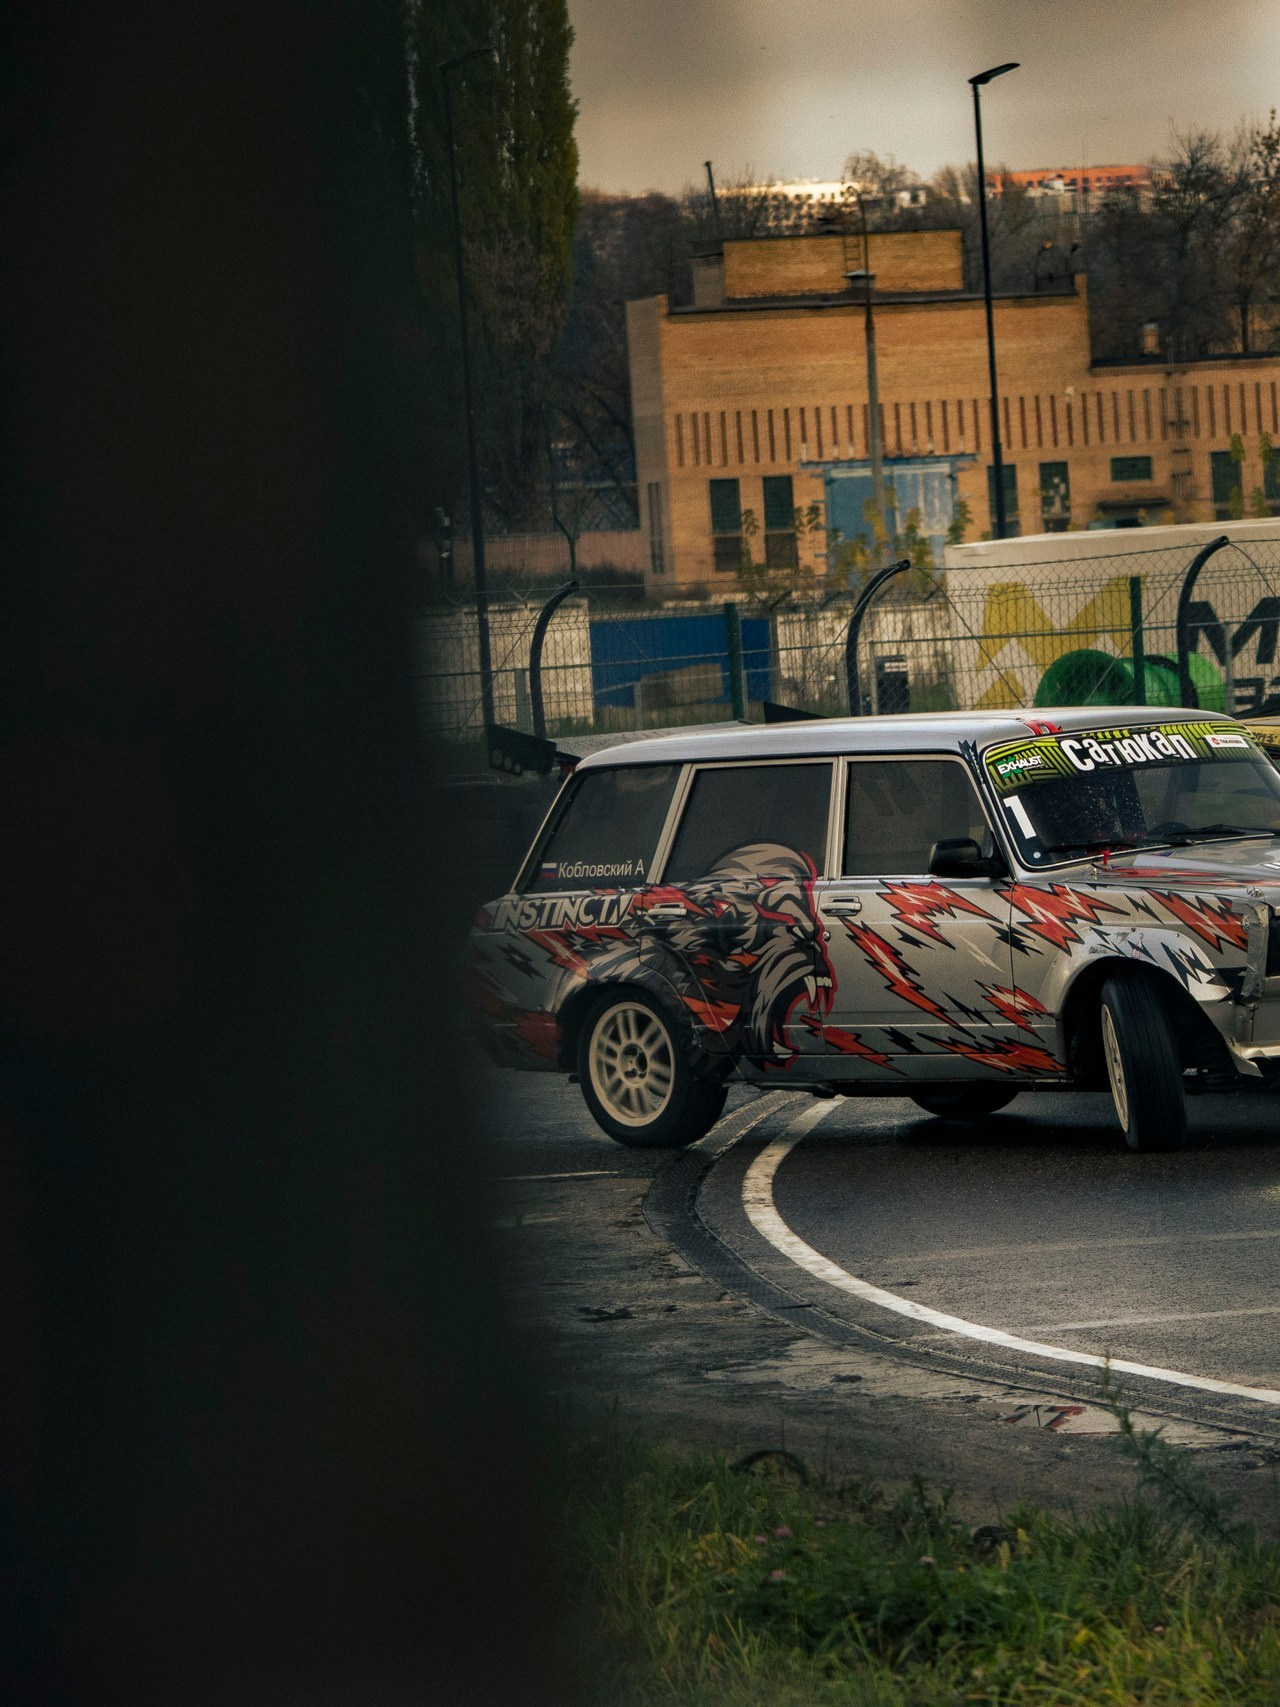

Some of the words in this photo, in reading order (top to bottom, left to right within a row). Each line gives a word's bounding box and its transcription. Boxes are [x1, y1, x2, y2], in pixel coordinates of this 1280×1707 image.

[997, 755, 1042, 774] EXHAUST
[1003, 795, 1037, 839] 1
[558, 860, 633, 878] Кобловский
[635, 859, 645, 875] А
